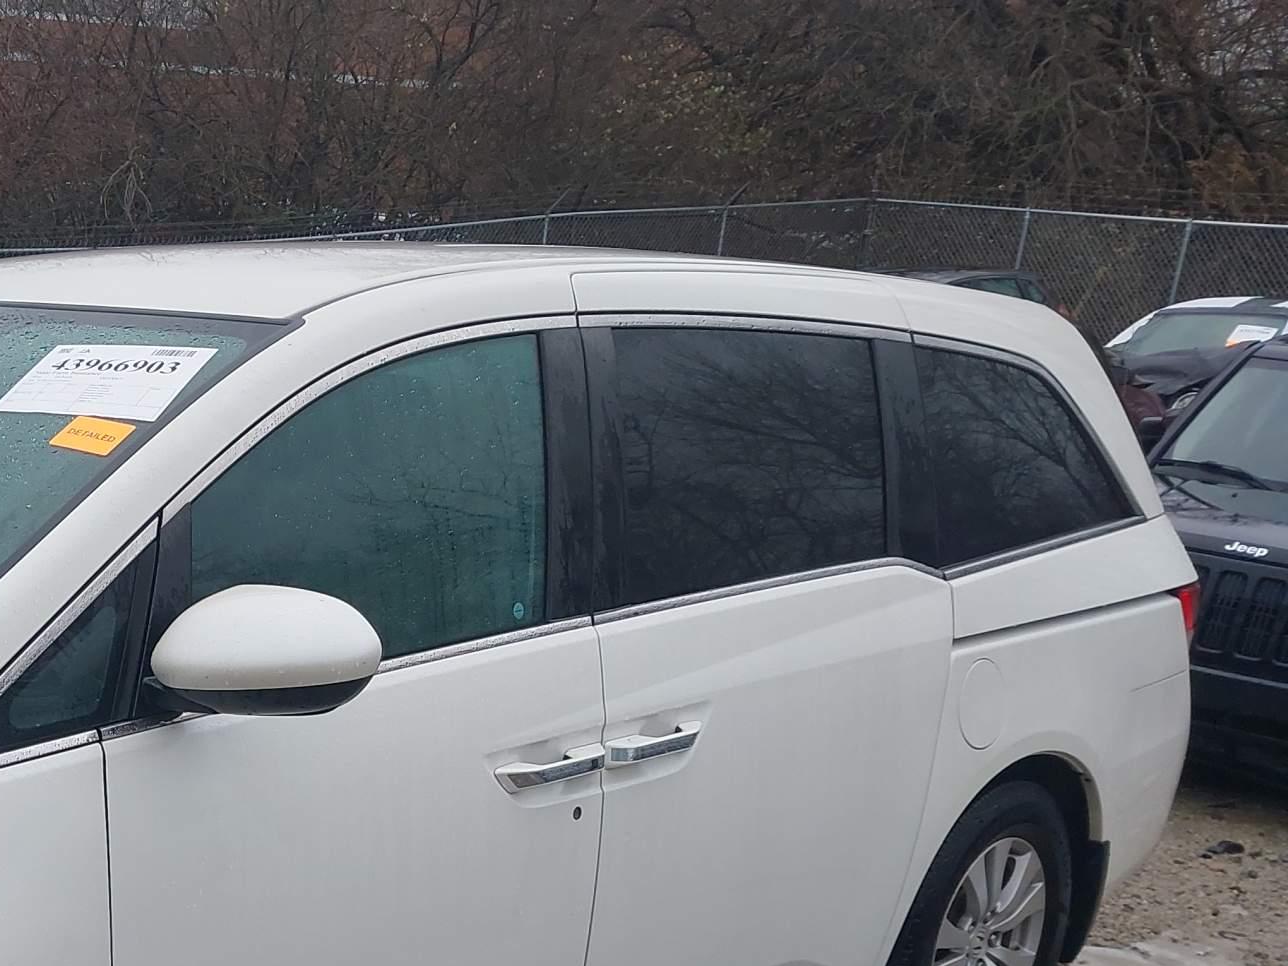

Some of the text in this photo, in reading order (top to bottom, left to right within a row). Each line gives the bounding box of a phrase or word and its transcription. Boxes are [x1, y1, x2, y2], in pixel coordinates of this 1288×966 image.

[51, 358, 181, 375] 43966903
[67, 427, 116, 443] DETAILED
[1224, 541, 1269, 557] Jeep
